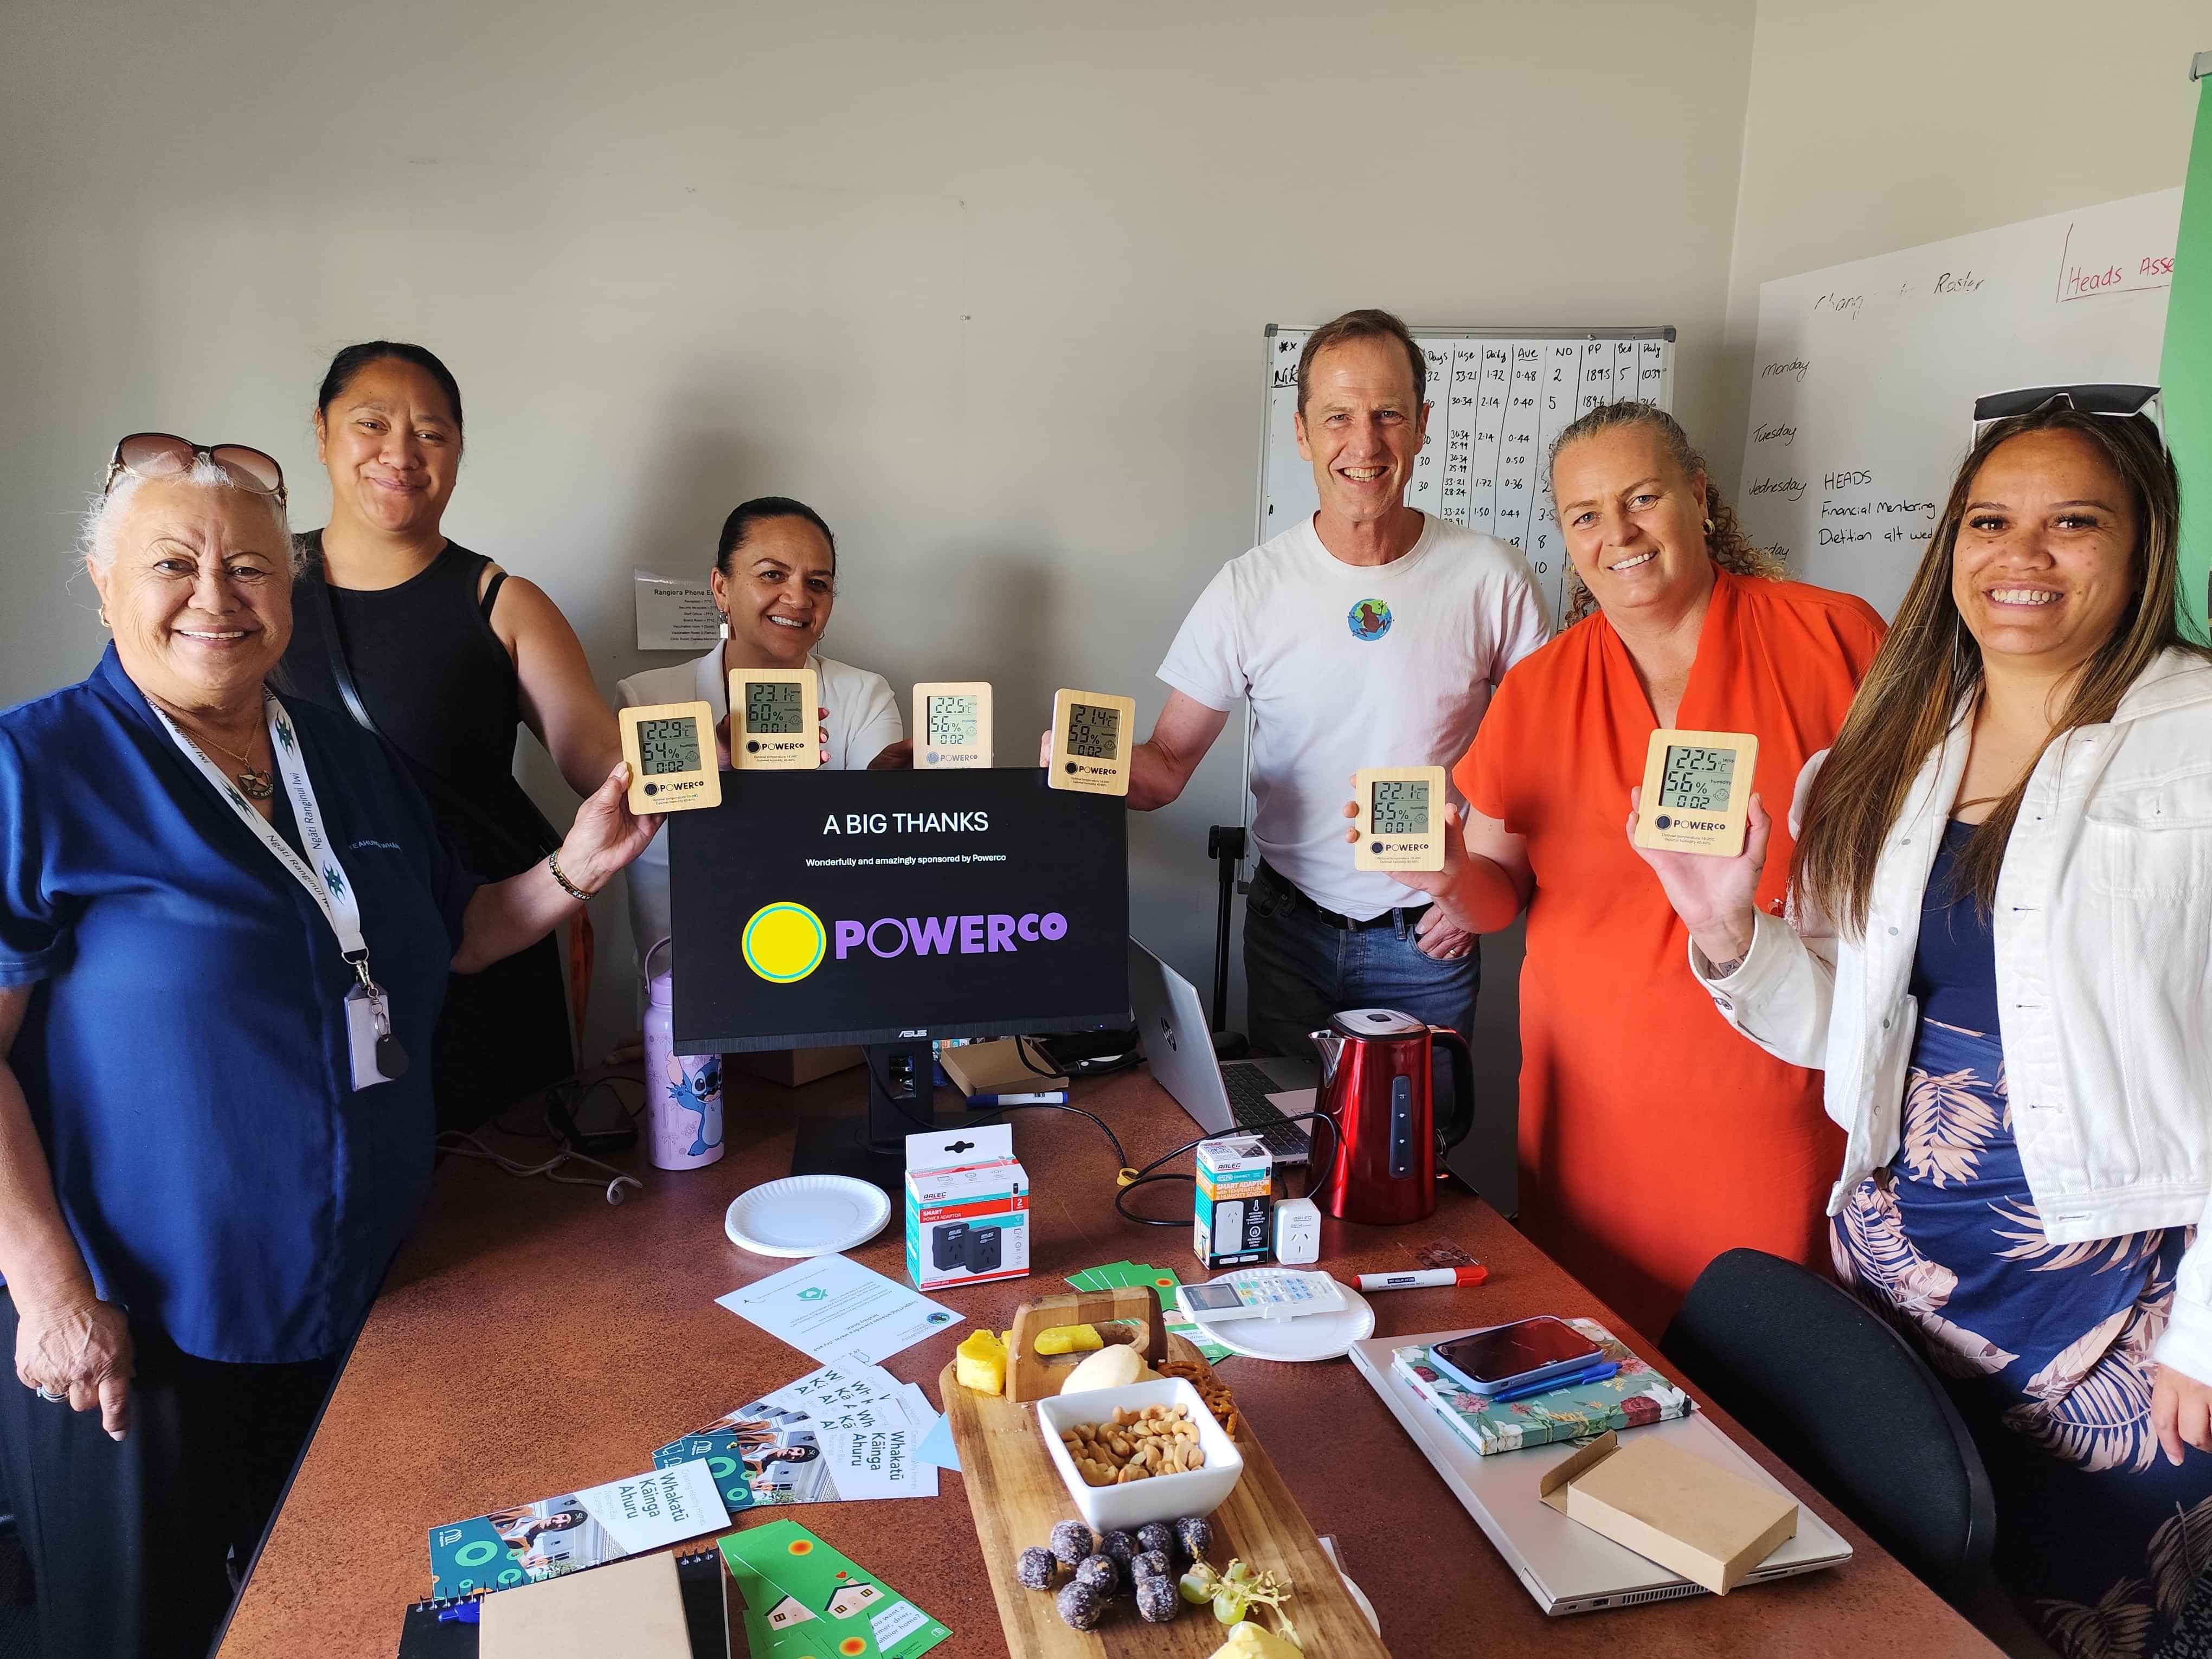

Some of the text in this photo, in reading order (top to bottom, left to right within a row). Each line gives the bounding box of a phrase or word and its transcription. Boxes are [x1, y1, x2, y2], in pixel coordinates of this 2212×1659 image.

[2066, 265, 2123, 295] Heads
[1428, 350, 1448, 365] Days
[1486, 350, 1506, 363] Daily
[1427, 371, 1440, 382] 32
[1553, 369, 1562, 382] 2
[1620, 366, 1631, 380] 5
[1761, 357, 1810, 382] Monday
[1548, 396, 1556, 409] 5
[1753, 423, 1797, 446] Tuesday
[1419, 456, 1430, 466] 30
[1418, 481, 1429, 491] 30
[1824, 470, 1872, 491] HEADS
[1822, 500, 1935, 519] Financial Mentoring
[1538, 535, 1546, 549] 8
[1818, 528, 1872, 545] Dietition
[1535, 562, 1547, 574] 10
[290, 773, 322, 850] Ngāti Ranginui Iwi
[823, 811, 989, 835] A BIG THANKS
[266, 834, 324, 897] Ngāti Ranginui
[806, 854, 1006, 867] Wonderfully and amazingly sponsored by Powerco
[898, 1030, 927, 1038] ASUS
[1239, 1179, 1270, 1188] ADAPTOR
[923, 1192, 947, 1200] ARLEC
[1017, 1198, 1023, 1206] 2
[940, 1212, 962, 1220] ADAPTOR
[851, 1433, 867, 1467] Ahuru
[867, 1432, 886, 1471] Kāinga
[889, 1431, 905, 1481] Whakatū
[618, 1486, 639, 1519] Ahuru
[639, 1478, 661, 1518] Kāinga
[659, 1472, 689, 1522] Whakatū
[884, 1609, 899, 1621] want
[893, 1612, 912, 1624] drier,
[898, 1613, 921, 1630] home?
